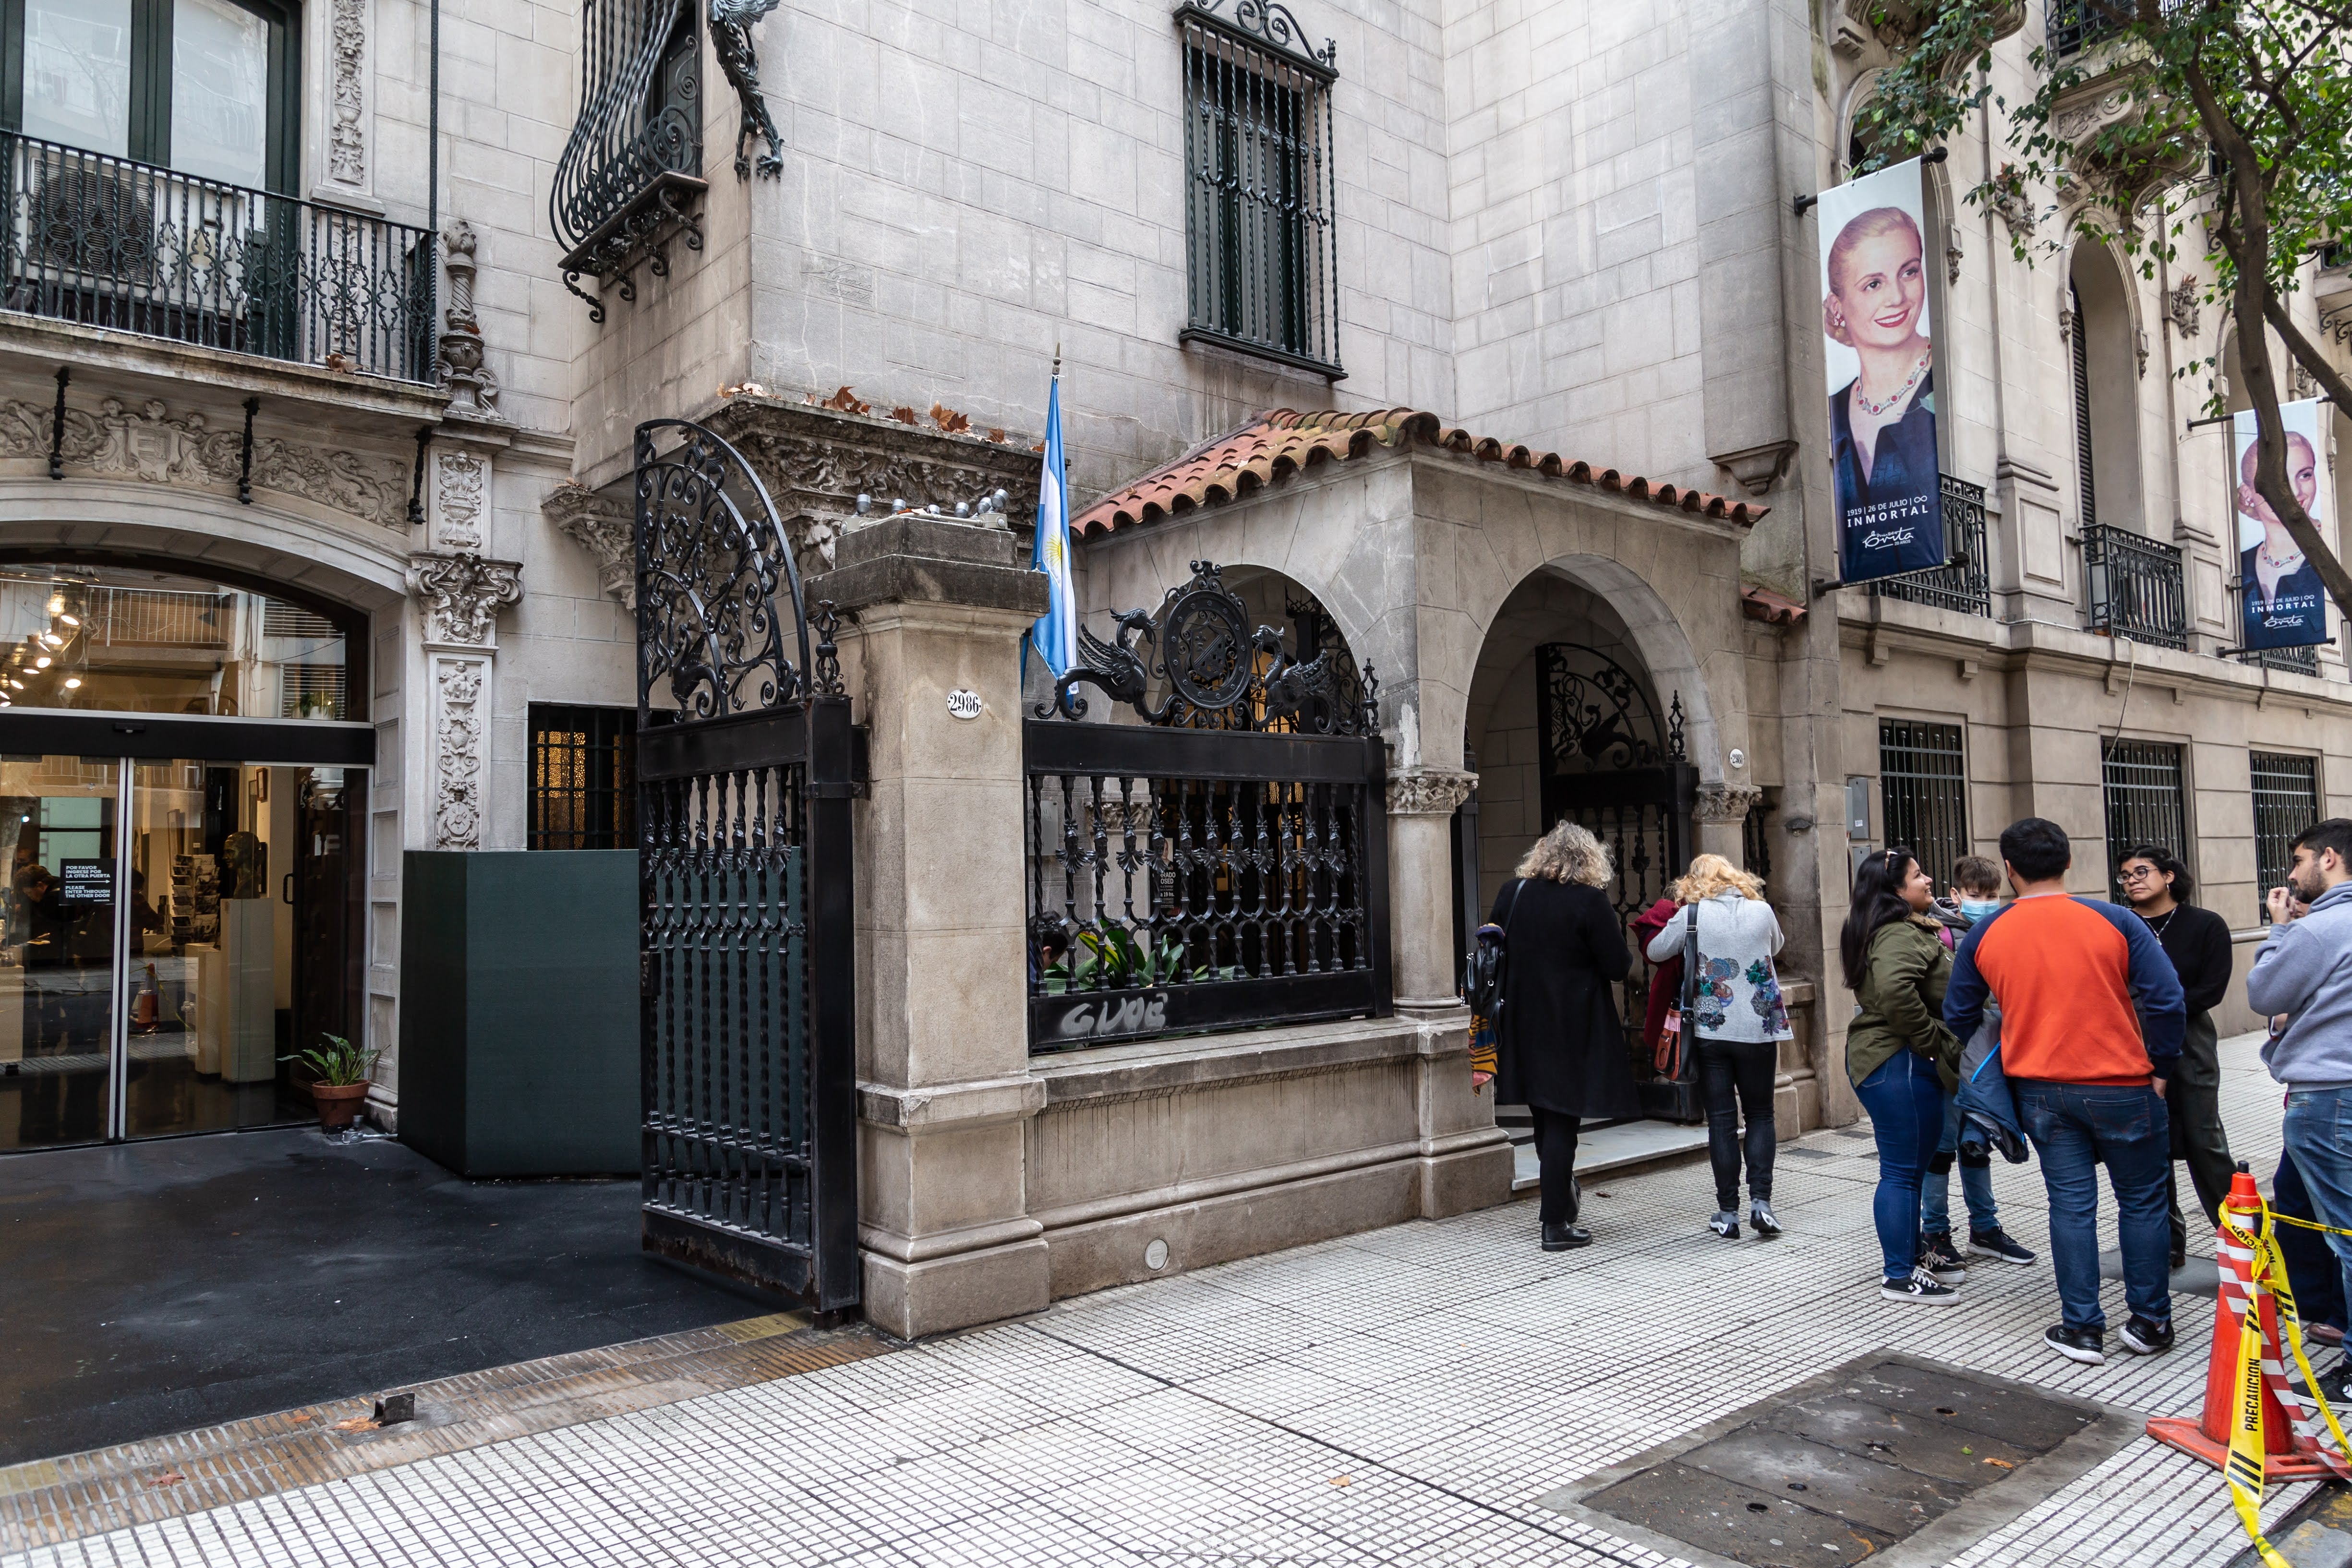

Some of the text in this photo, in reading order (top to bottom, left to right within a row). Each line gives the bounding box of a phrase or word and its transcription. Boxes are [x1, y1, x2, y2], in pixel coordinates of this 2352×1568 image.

[1847, 508, 1862, 517] 1919
[1889, 499, 1907, 509] JULIO
[1847, 505, 1929, 528] INMORTAL
[2252, 601, 2315, 614] INMORTAL
[950, 694, 979, 713] 2986
[1732, 754, 1743, 764] 2988
[2244, 1358, 2260, 1432] PRECAUCION
